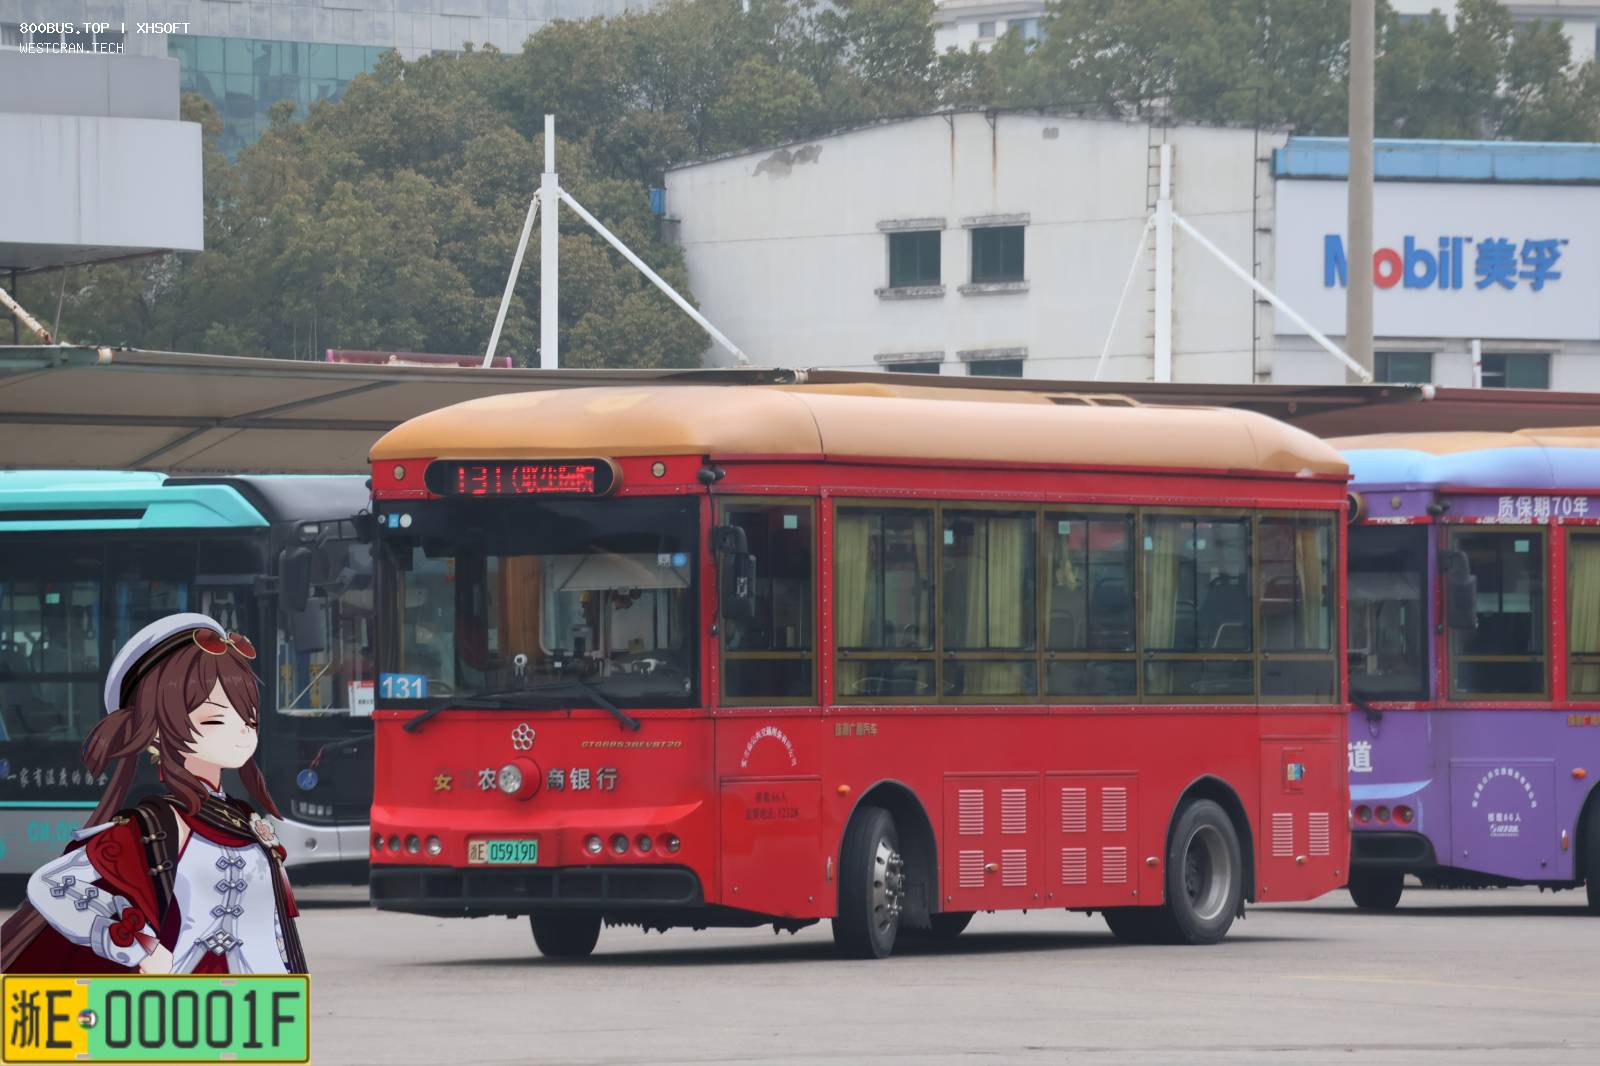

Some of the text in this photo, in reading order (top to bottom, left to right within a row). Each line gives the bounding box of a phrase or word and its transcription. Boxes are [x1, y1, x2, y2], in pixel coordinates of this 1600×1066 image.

[1475, 237, 1562, 292] 美孚
[457, 466, 502, 495] 131
[1498, 496, 1588, 518] 质保期70年
[382, 679, 422, 699] 131
